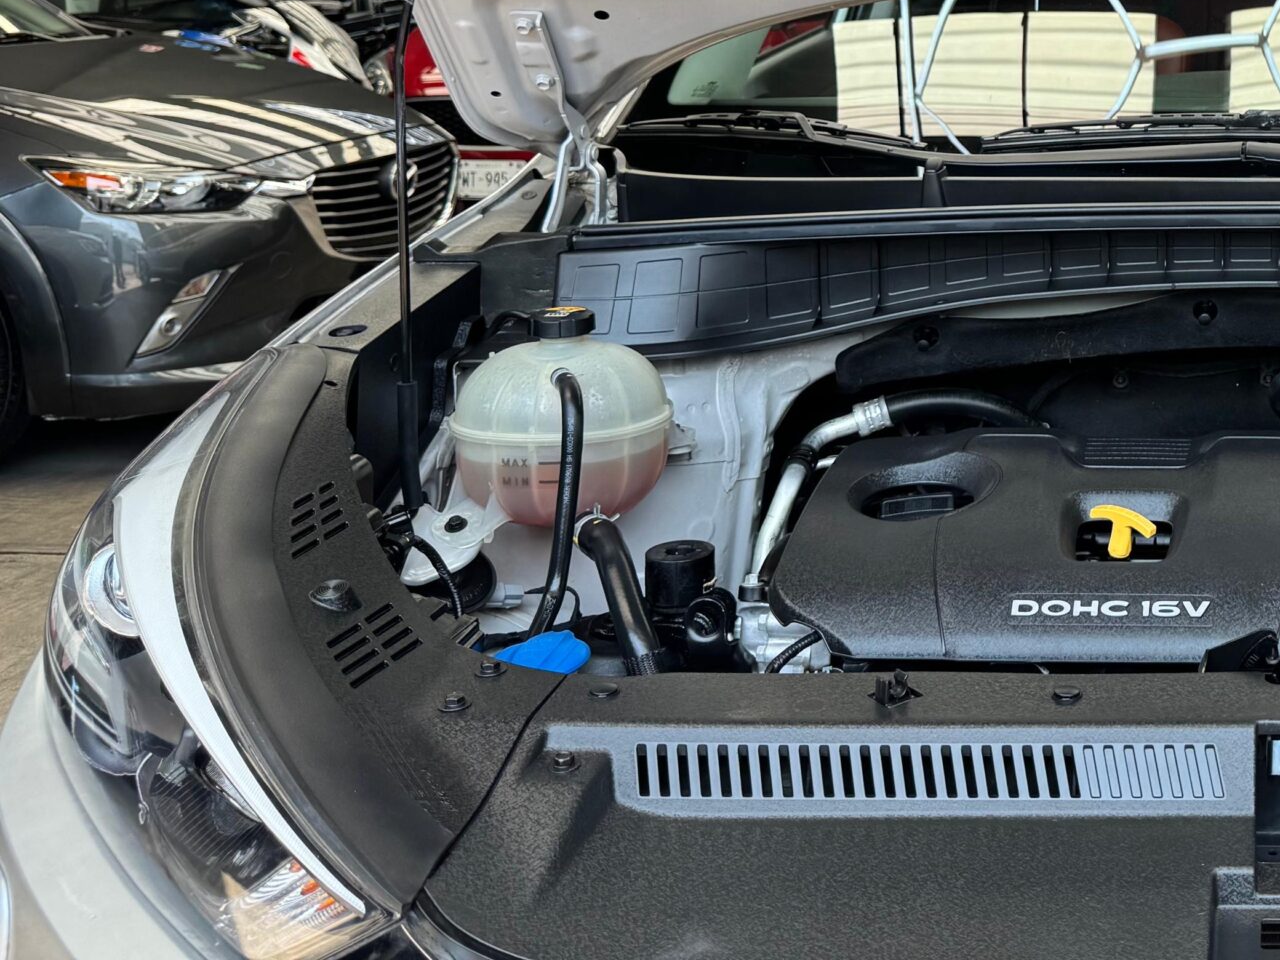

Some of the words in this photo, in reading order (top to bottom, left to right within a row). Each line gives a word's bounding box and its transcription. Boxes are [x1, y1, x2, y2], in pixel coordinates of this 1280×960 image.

[501, 457, 529, 468] MAX
[502, 476, 529, 487] MIN
[1010, 599, 1130, 617] DOHC
[1141, 600, 1211, 618] 16V
